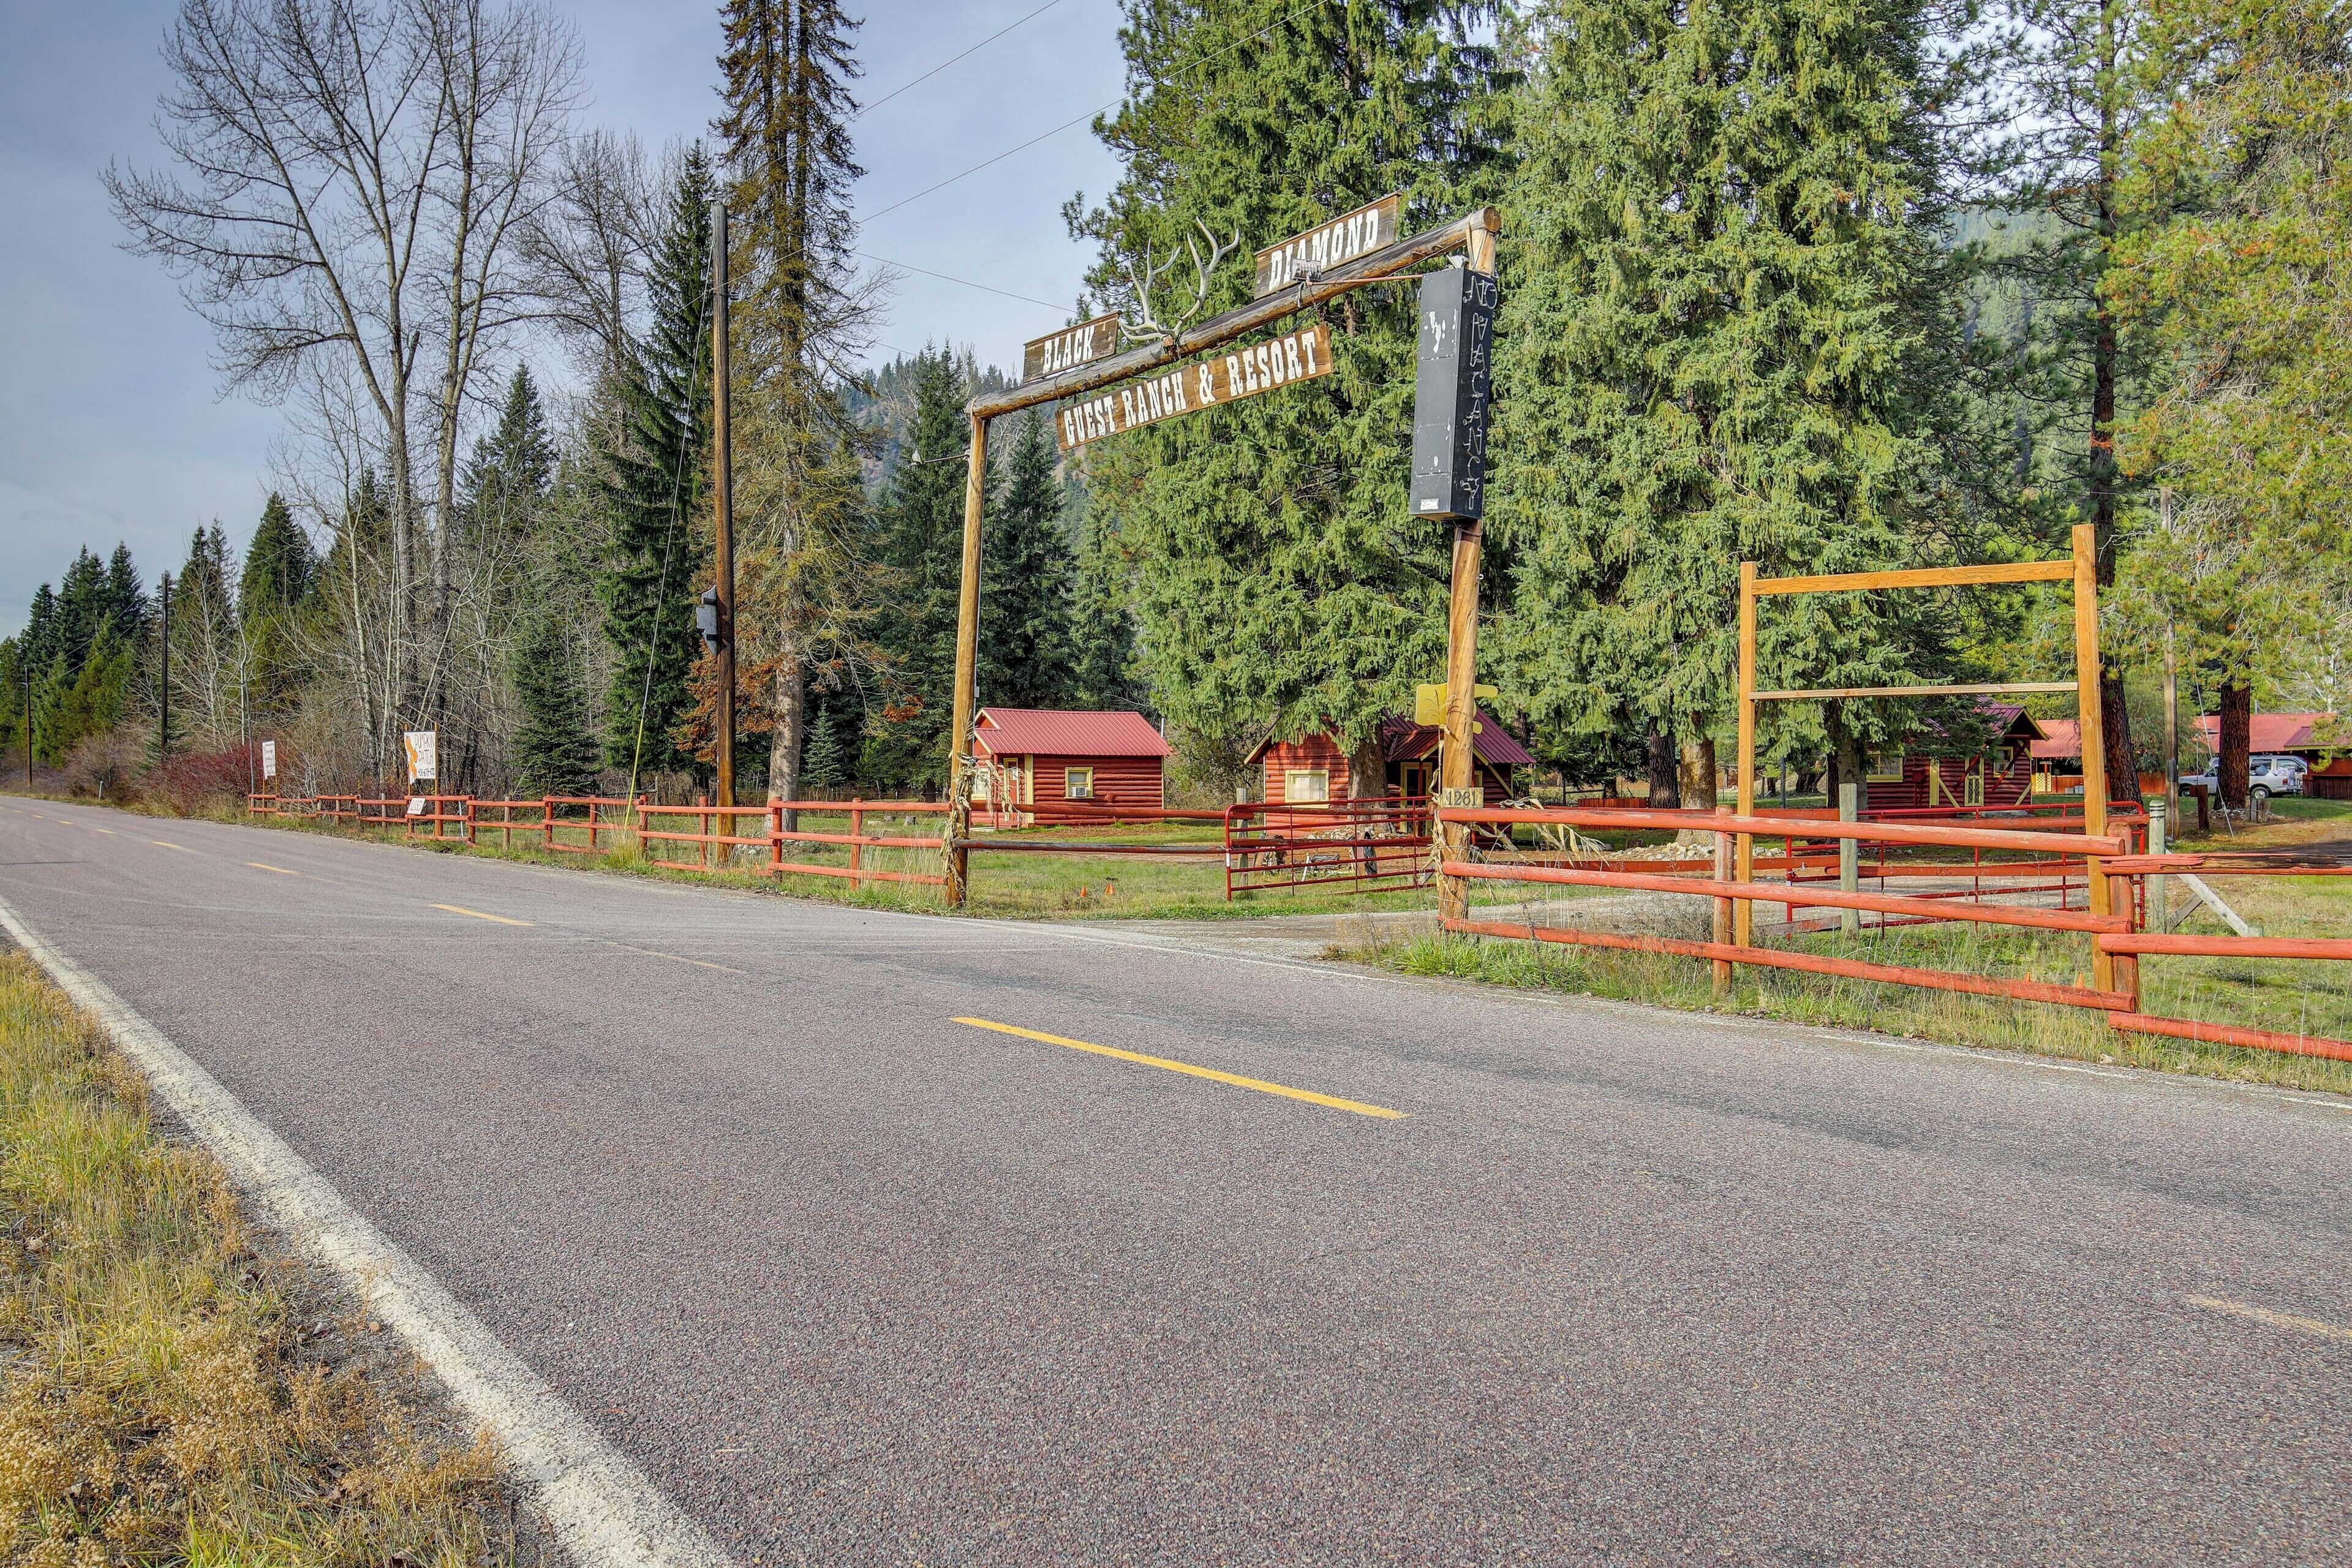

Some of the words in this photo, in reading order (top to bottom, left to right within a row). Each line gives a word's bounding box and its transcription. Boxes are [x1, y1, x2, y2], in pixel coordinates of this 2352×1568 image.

[1268, 209, 1379, 292] DIAMOND
[1468, 275, 1498, 309] NO
[1042, 324, 1095, 374] BLACK
[1064, 395, 1115, 447] GUEST
[1121, 371, 1186, 428] RANCH
[1199, 363, 1216, 405] &
[1226, 331, 1316, 397] RESORT
[1466, 312, 1488, 511] VACANCY
[415, 733, 435, 748] PUMPKIN
[419, 749, 434, 765] PATCH
[1448, 790, 1476, 806] 1281
